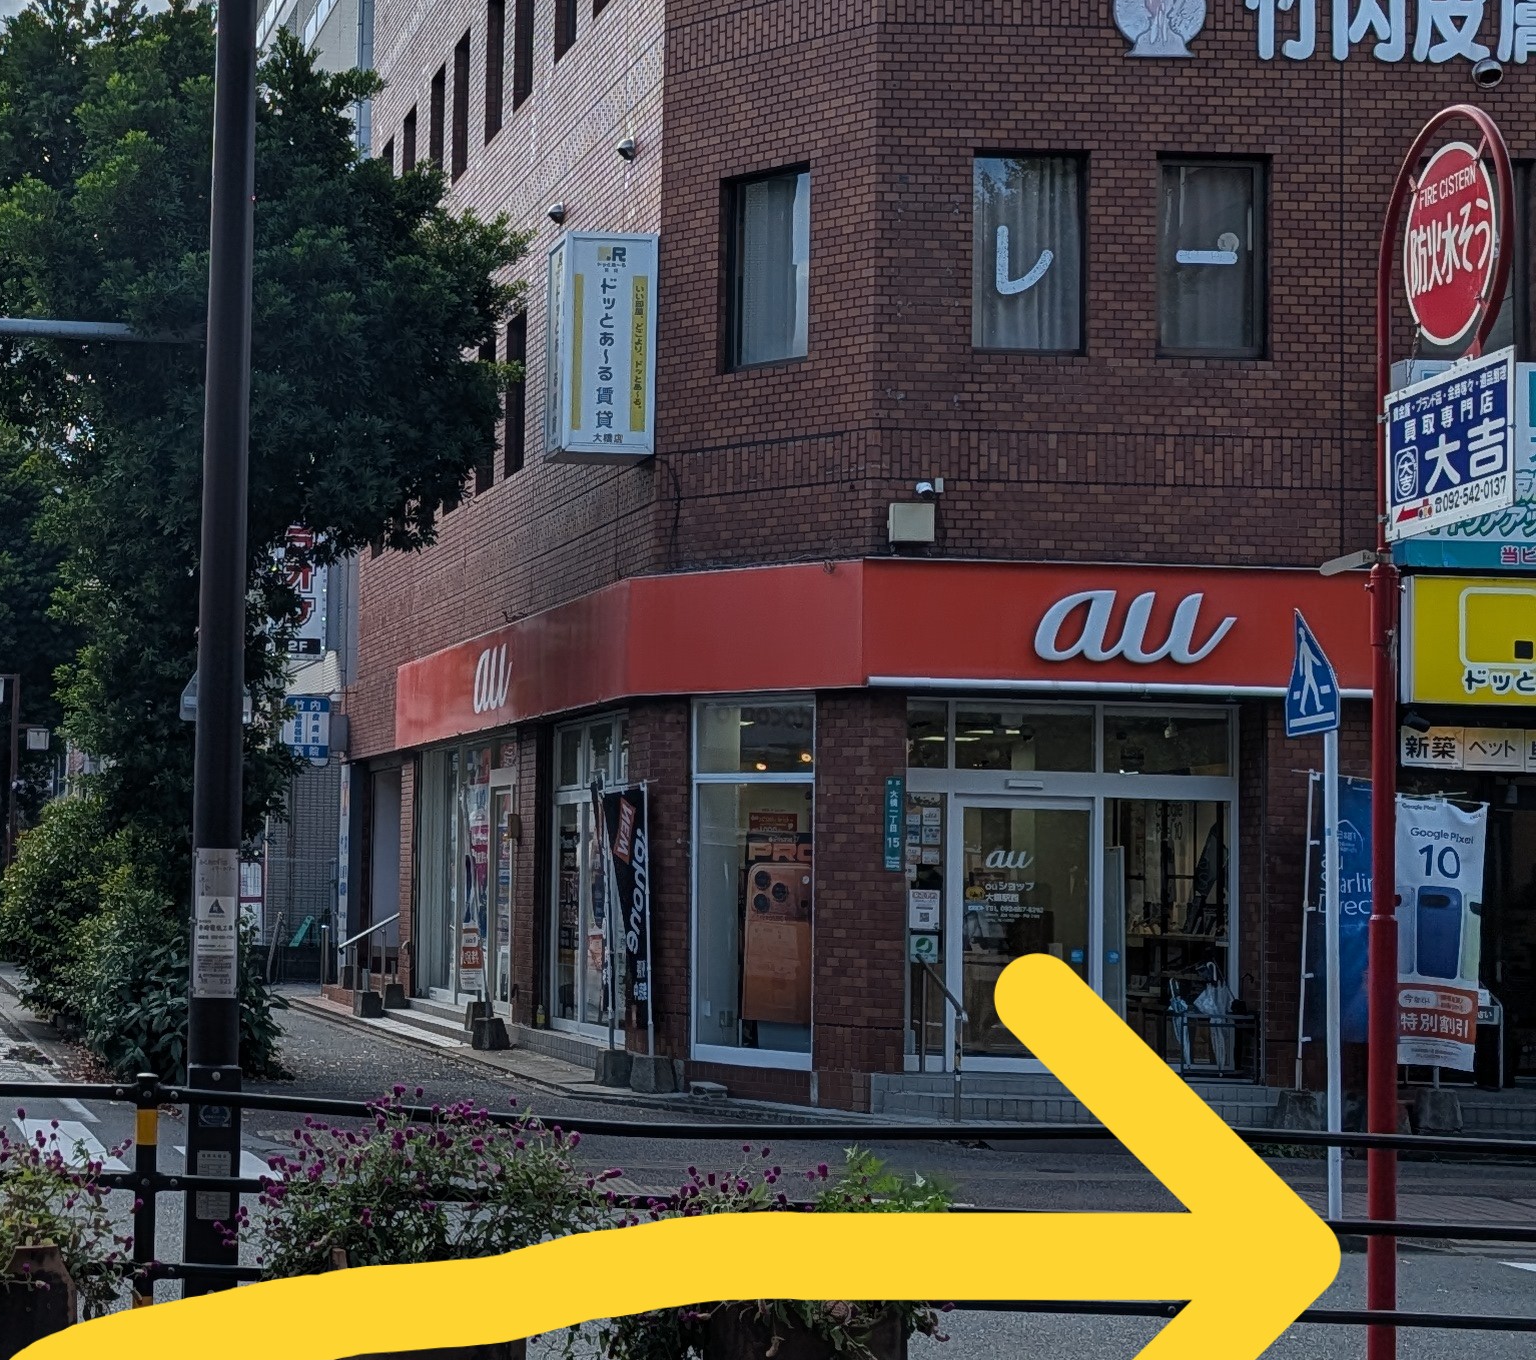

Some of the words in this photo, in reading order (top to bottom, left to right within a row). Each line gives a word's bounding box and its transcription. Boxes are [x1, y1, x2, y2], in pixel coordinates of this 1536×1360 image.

[1419, 183, 1437, 210] FIRE
[1439, 164, 1477, 199] CISTERN
[1410, 198, 1491, 298] 防火水そう
[1404, 390, 1494, 444] 買取専門店
[1424, 417, 1506, 494] 大吉
[1032, 587, 1238, 665] au
[287, 640, 308, 652] 2F
[472, 642, 513, 715] au
[1464, 669, 1536, 692] ドッと
[1405, 736, 1456, 759] 新築
[1468, 738, 1516, 758] ペット
[889, 790, 899, 833] 大橋一丁目
[886, 837, 900, 848] 15
[1410, 827, 1449, 840] Google
[1450, 832, 1474, 845] Pixel
[985, 850, 1034, 869] au
[1418, 844, 1461, 879] 10
[1400, 1012, 1469, 1039] 特別割引
